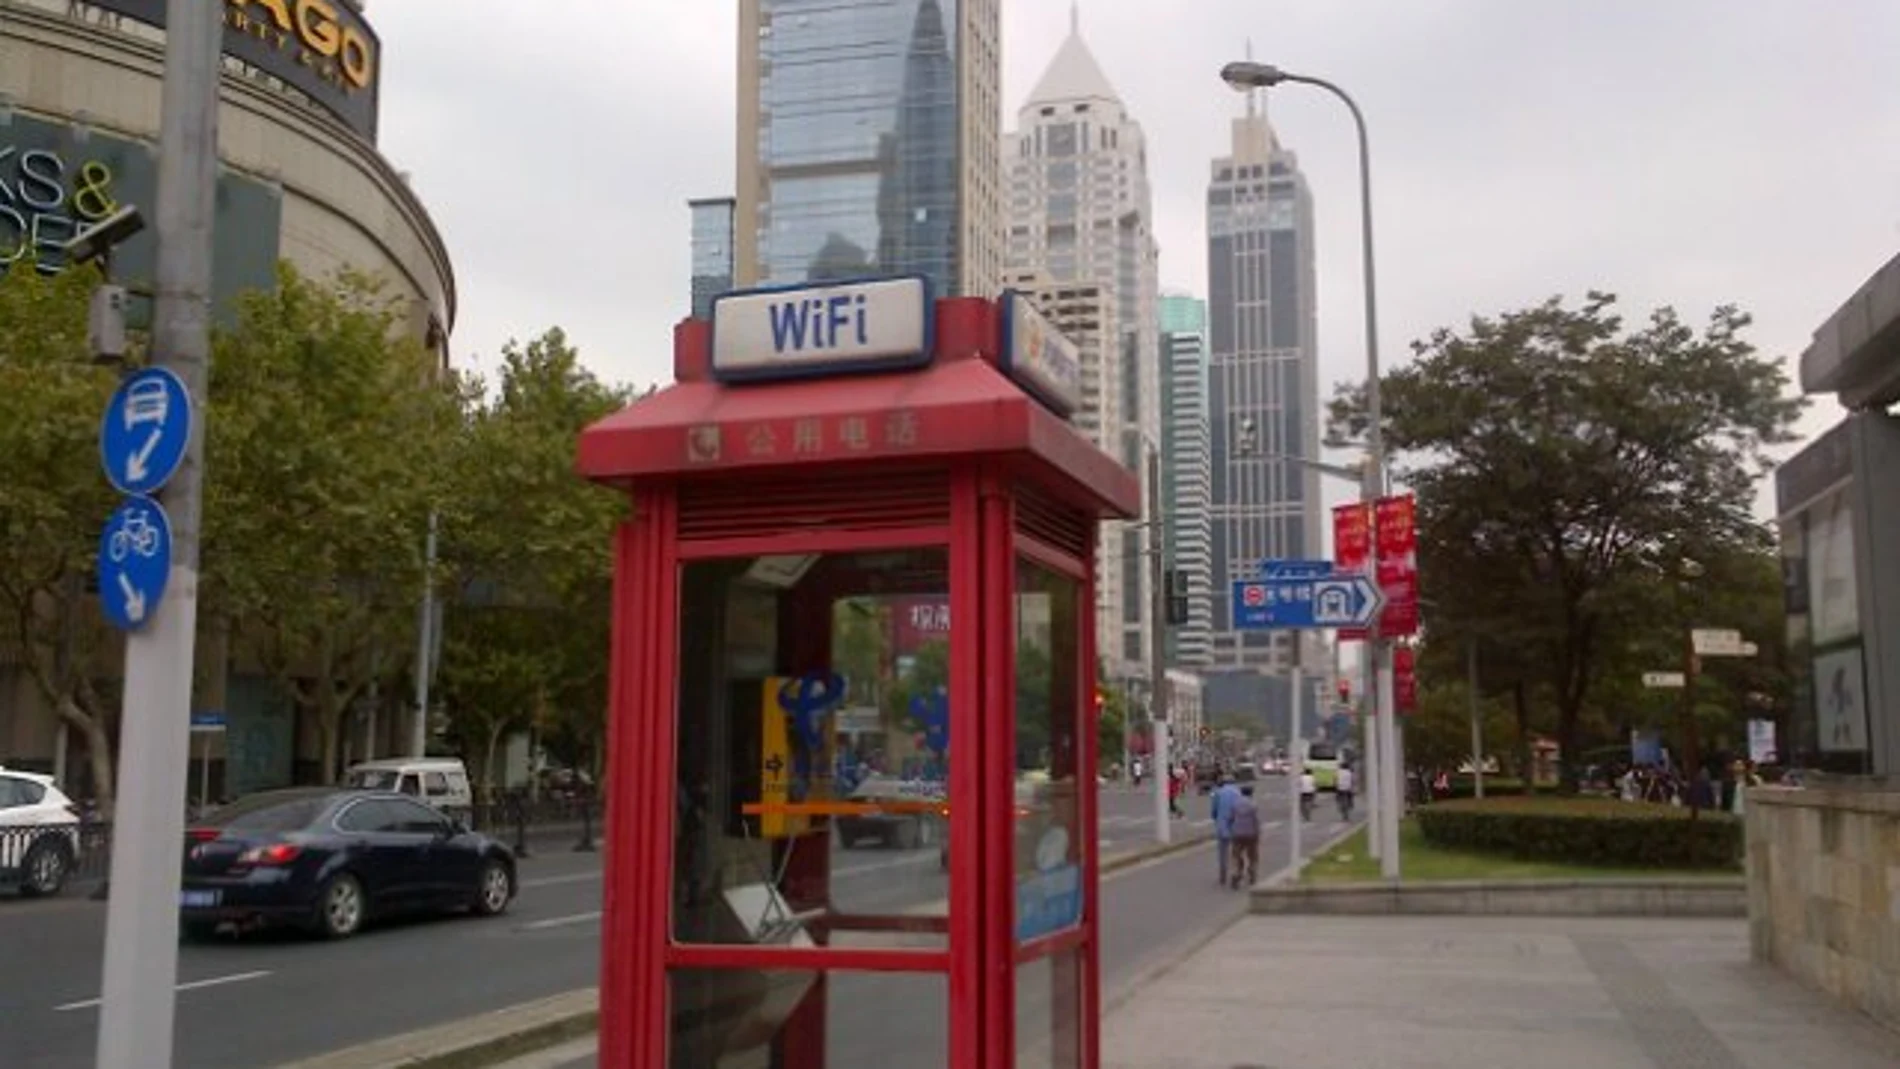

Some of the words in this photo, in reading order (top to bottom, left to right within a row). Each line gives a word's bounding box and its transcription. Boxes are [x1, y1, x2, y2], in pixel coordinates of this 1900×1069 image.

[75, 160, 116, 220] &
[769, 293, 868, 353] WiFi
[746, 410, 918, 461] 公用电话
